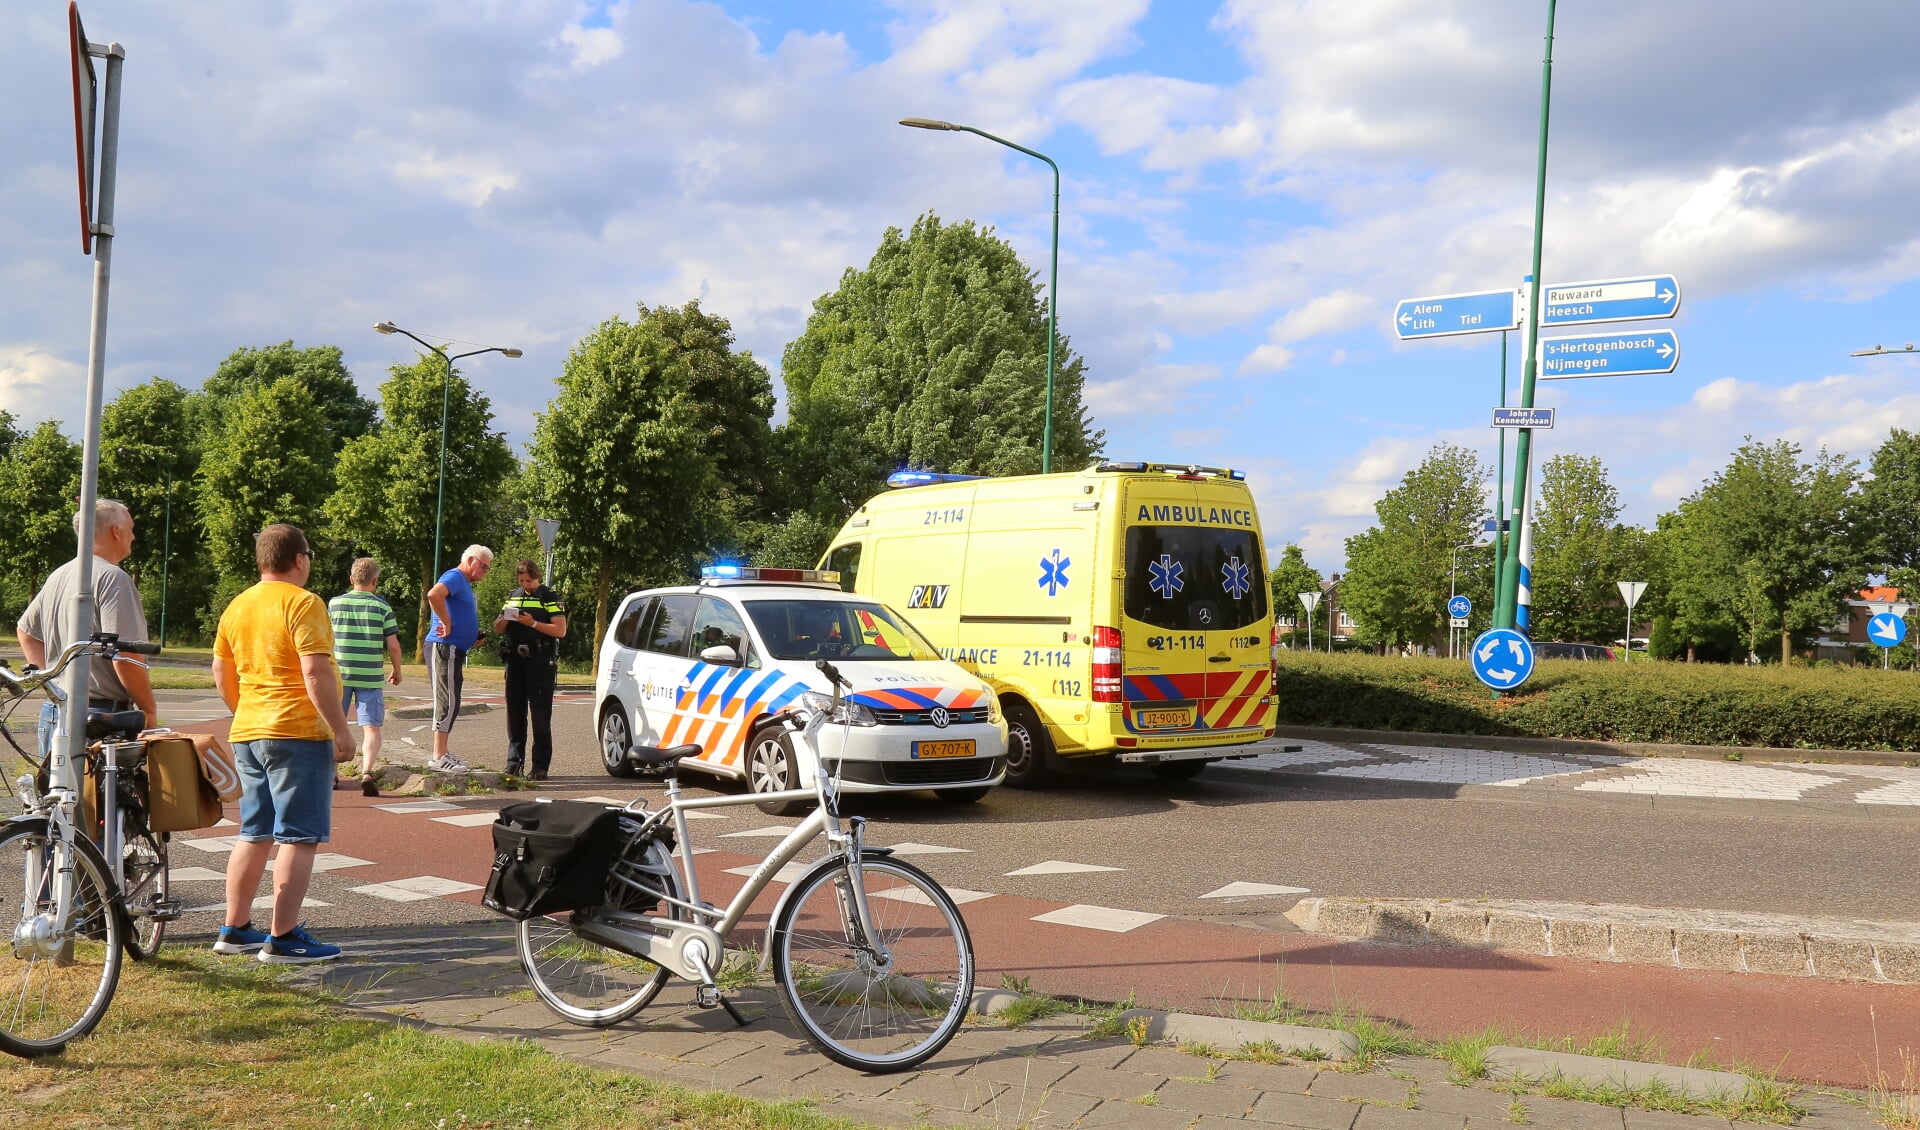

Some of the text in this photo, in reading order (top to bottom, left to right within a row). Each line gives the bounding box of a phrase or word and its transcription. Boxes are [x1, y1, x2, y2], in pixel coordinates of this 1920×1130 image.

[1550, 288, 1602, 301] Ruwaard
[1413, 304, 1442, 315] Alem
[1547, 304, 1593, 317] Heesch
[1413, 314, 1482, 329] Lith Tiel
[1547, 337, 1655, 354] 's-Hertogenbosch
[1546, 358, 1608, 372] Nijmegen
[1495, 417, 1549, 426] Kennedybaan
[924, 508, 964, 525] 21-114
[1137, 504, 1252, 527] AMBULANCE
[908, 585, 950, 608] RAV
[1155, 635, 1205, 650] 21-114
[1023, 650, 1071, 667] 21-114
[642, 683, 673, 700] POLITIE
[1147, 712, 1187, 724] JZ-900-X
[922, 743, 971, 756] GX-707-K
